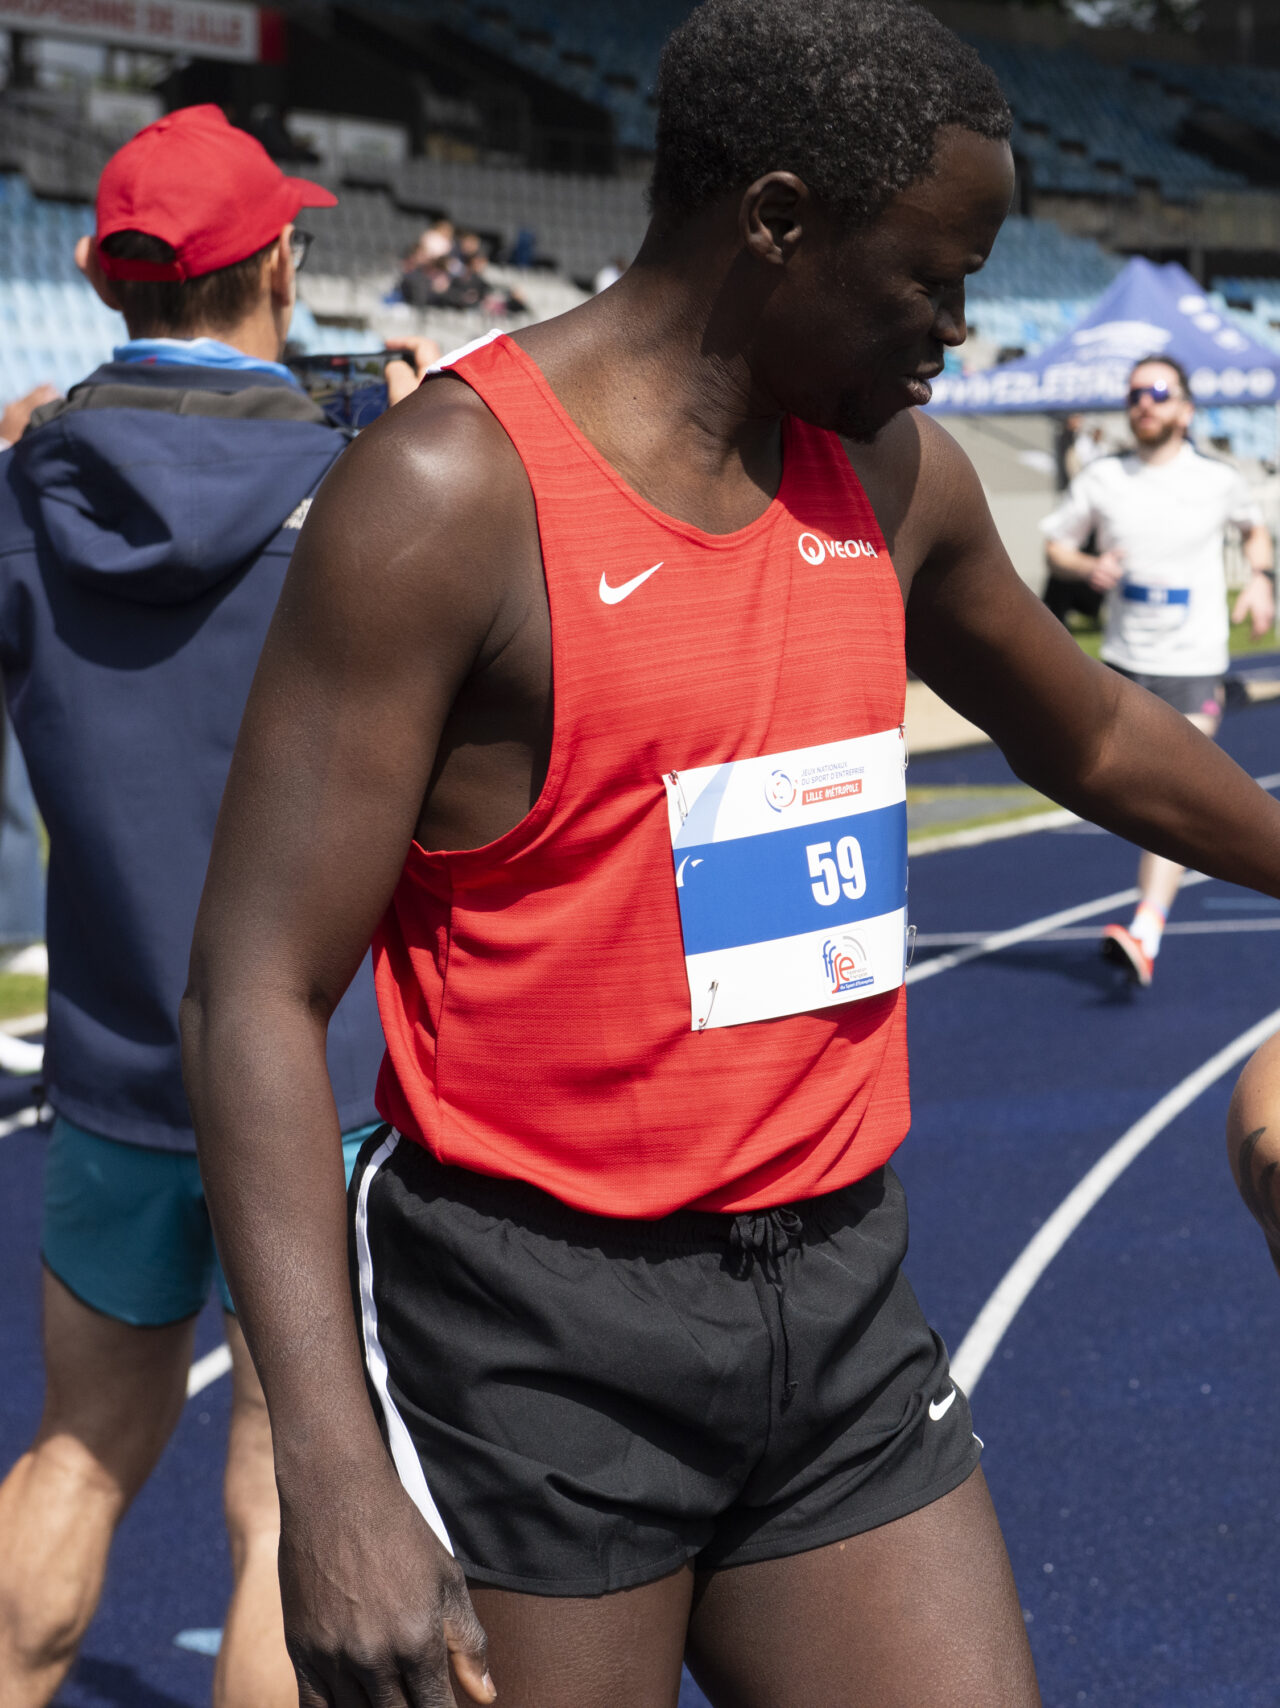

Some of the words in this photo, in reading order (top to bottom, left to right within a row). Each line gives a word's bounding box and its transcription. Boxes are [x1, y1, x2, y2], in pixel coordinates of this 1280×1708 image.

[823, 539, 878, 558] VEOLA
[805, 790, 823, 802] LILLE
[805, 835, 867, 906] 59
